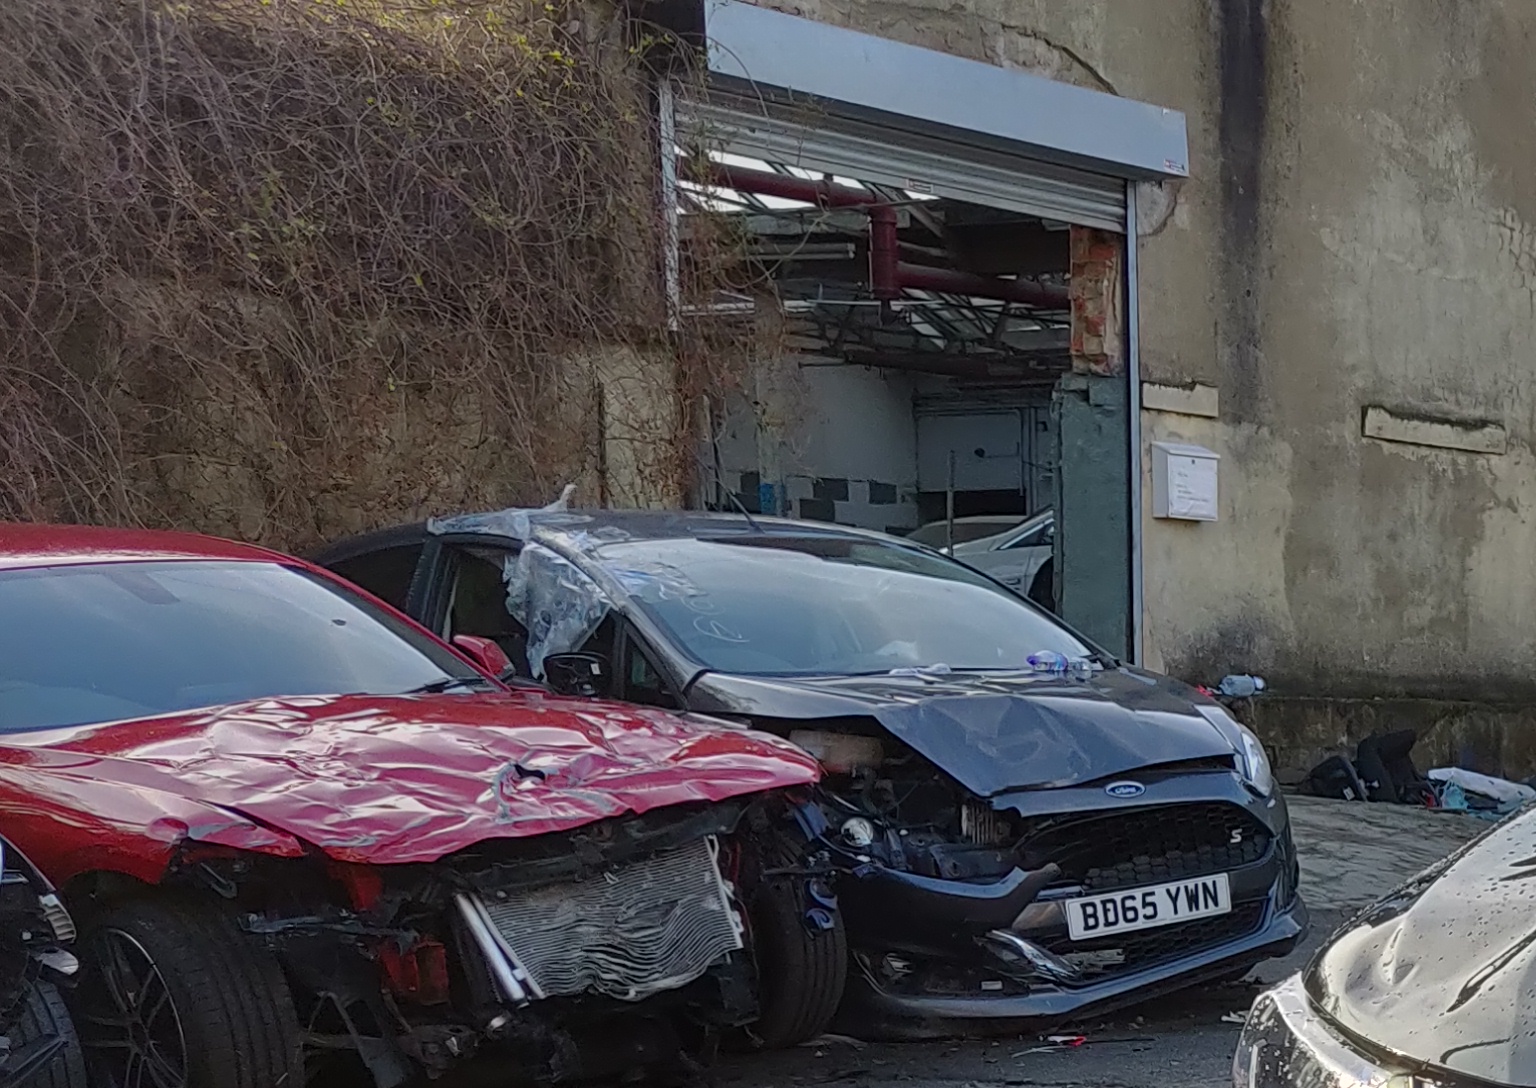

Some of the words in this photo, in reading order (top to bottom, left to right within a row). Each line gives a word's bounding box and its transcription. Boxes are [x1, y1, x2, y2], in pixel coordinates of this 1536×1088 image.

[1229, 828, 1243, 844] S
[1079, 891, 1159, 931] BD65
[1165, 879, 1220, 916] YWN
